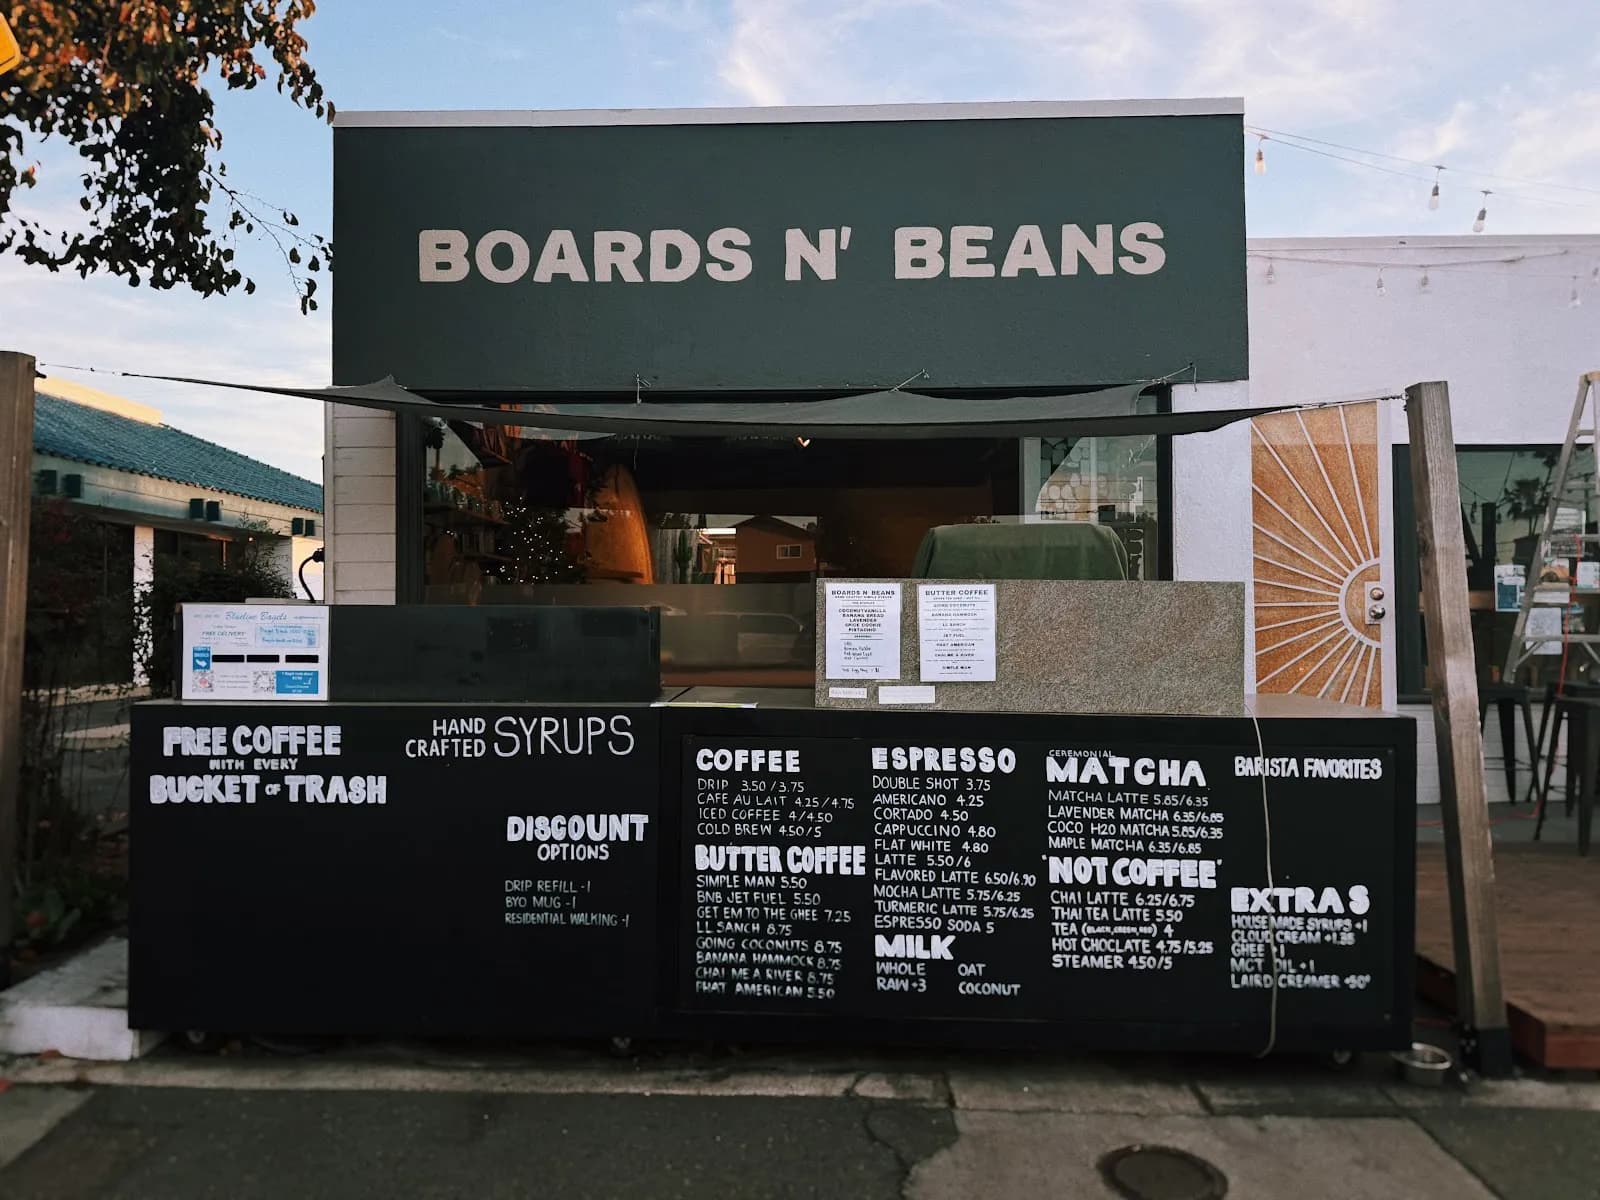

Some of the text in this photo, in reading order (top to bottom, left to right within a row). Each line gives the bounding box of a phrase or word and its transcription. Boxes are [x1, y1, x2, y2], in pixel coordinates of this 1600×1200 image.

[419, 222, 1166, 283] BOARDS N' BEANS
[433, 718, 486, 736] HAND
[163, 725, 341, 756] FREE COFFEE
[494, 715, 634, 757] SYRUPS
[406, 739, 486, 757] CRAFTED
[1048, 750, 1117, 759] CEREMONIAL
[209, 758, 298, 770] WITH EVERY
[696, 749, 800, 772] COFFEE
[872, 747, 1016, 773] ESPRESSO
[1235, 755, 1382, 779] BARISTA FAVORITES
[1046, 755, 1206, 786] MATCHA
[150, 775, 386, 804] BUCKET OF TRASH
[698, 778, 728, 790] DRIP
[873, 775, 990, 791] DOUBLE SHOT 3.75
[698, 793, 728, 804] CAFE
[733, 794, 750, 805] AU
[756, 796, 786, 805] LAIT
[873, 794, 984, 807] AMERICANO 4.25
[1049, 790, 1103, 802] MATCHA
[1108, 792, 1148, 804] LATTE
[700, 808, 726, 819] ICED
[732, 809, 779, 821] COFFEE
[874, 807, 968, 821] CORTADO 4.50
[1049, 805, 1115, 819] LAVENDER
[1120, 807, 1169, 821] MATCHA
[507, 814, 648, 841] DISCOUNT
[697, 823, 730, 835] COLD
[735, 824, 771, 835] BREW
[875, 823, 996, 837] CAPPUCCINO 4.80
[1048, 821, 1083, 834] COCO
[1120, 824, 1170, 836] MATCHA
[875, 839, 988, 853] FLAT WHITE 4.80
[1049, 836, 1085, 849] MAPLE
[1091, 838, 1144, 851] MATCHA
[537, 843, 609, 861] OPTIONS
[695, 843, 865, 875] BUTTER COFFEE
[875, 853, 916, 865] LATTE
[697, 875, 807, 889] SIMPLE MAN 5.50
[875, 868, 936, 882] FLAVORED
[942, 871, 979, 883] LATTE
[505, 880, 577, 893] DRIP REFILL
[874, 884, 918, 898] MOCHA
[922, 886, 960, 900] LATTE
[506, 896, 561, 908] BYO MUG
[697, 890, 820, 905] BNB JET FUEL 5.50
[1050, 890, 1081, 904] CHAI
[1087, 891, 1128, 905] LATTE
[1231, 884, 1370, 916] EXTRAS
[697, 906, 851, 922] GET EM TO THE GHEE 7.25
[874, 900, 937, 914] TURMERIC
[943, 904, 977, 916] LATTE
[1051, 906, 1183, 922] THAI TEA LATTE 5.50
[505, 912, 617, 926] RESIDENTIAL WALKING
[875, 915, 994, 933] ESPRESSO SODA 5
[1231, 914, 1352, 933] HOUSE MADE SYRUPS
[717, 921, 760, 933] SANCH
[767, 924, 792, 936] 8.75
[1052, 922, 1174, 938] TEA 4
[1232, 928, 1321, 946] CLOUD CREAM
[696, 937, 842, 953] GOING COCONUTS 8.75
[875, 935, 955, 960] MILK
[1052, 937, 1077, 951] HOT
[1081, 937, 1151, 954] CHOCLATE
[1231, 942, 1264, 957] GHEE
[697, 951, 841, 970] BANANA HAMMOCK 8.75
[876, 961, 925, 975] WHOLE
[1052, 954, 1124, 969] STEAMER
[1231, 956, 1296, 975] MCT OIL
[696, 967, 833, 985] CHAI ME A RIVER 8.75
[958, 964, 986, 976] OAT
[877, 977, 908, 991] RAW
[959, 981, 1020, 995] COCONUT
[1231, 974, 1340, 988] LAIRD CREAMER
[736, 983, 802, 996] AMERICAN
